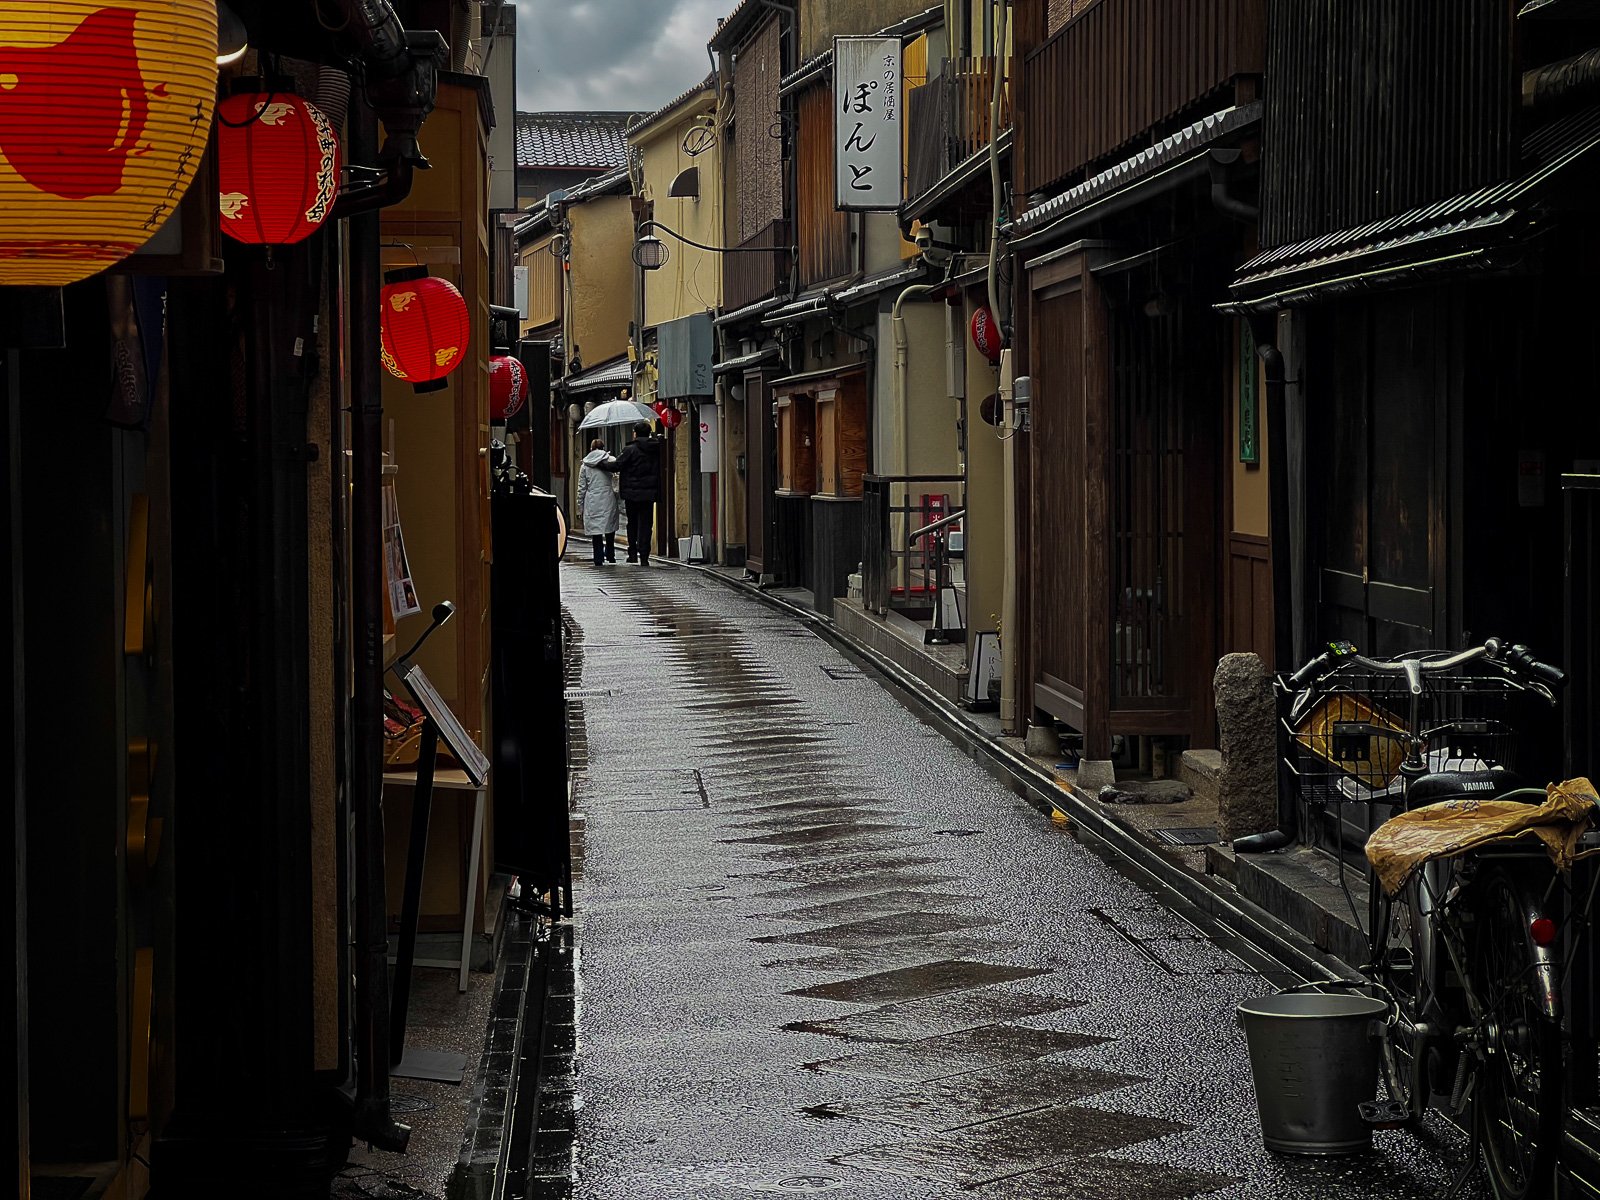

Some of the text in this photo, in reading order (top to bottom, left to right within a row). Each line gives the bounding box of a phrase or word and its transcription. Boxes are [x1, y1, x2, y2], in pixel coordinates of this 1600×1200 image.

[882, 54, 896, 121] 京の居酒屋
[304, 102, 336, 222] 先斗町のれん会
[842, 80, 878, 191] ぽんと
[1462, 781, 1495, 791] YAMAHA
